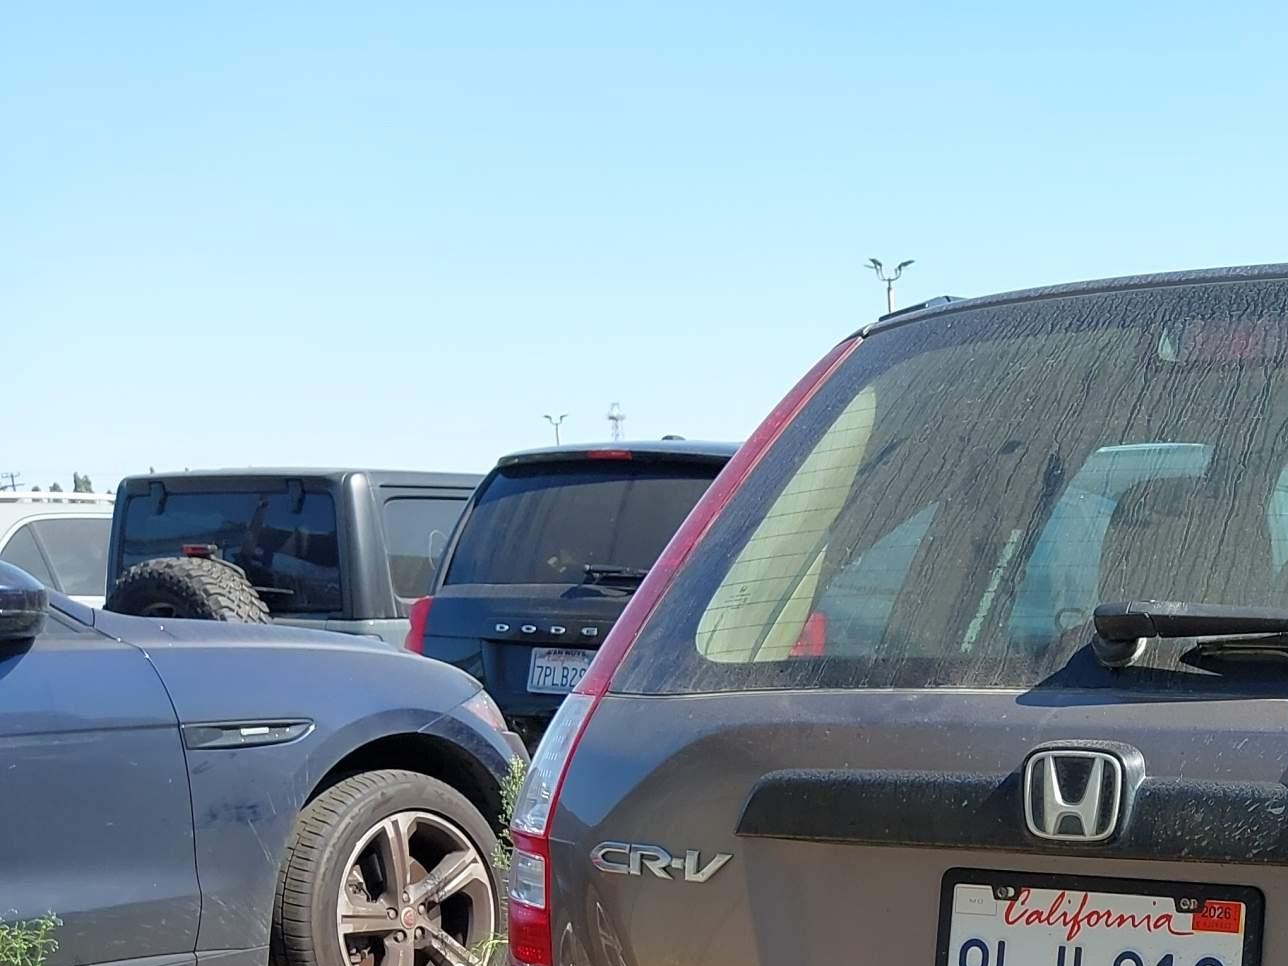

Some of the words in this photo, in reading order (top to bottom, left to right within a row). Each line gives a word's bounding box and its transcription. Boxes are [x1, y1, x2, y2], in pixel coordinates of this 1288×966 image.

[495, 623, 598, 636] DODG
[590, 840, 734, 883] CR-V
[1004, 888, 1195, 942] California
[1201, 904, 1233, 920] 2026
